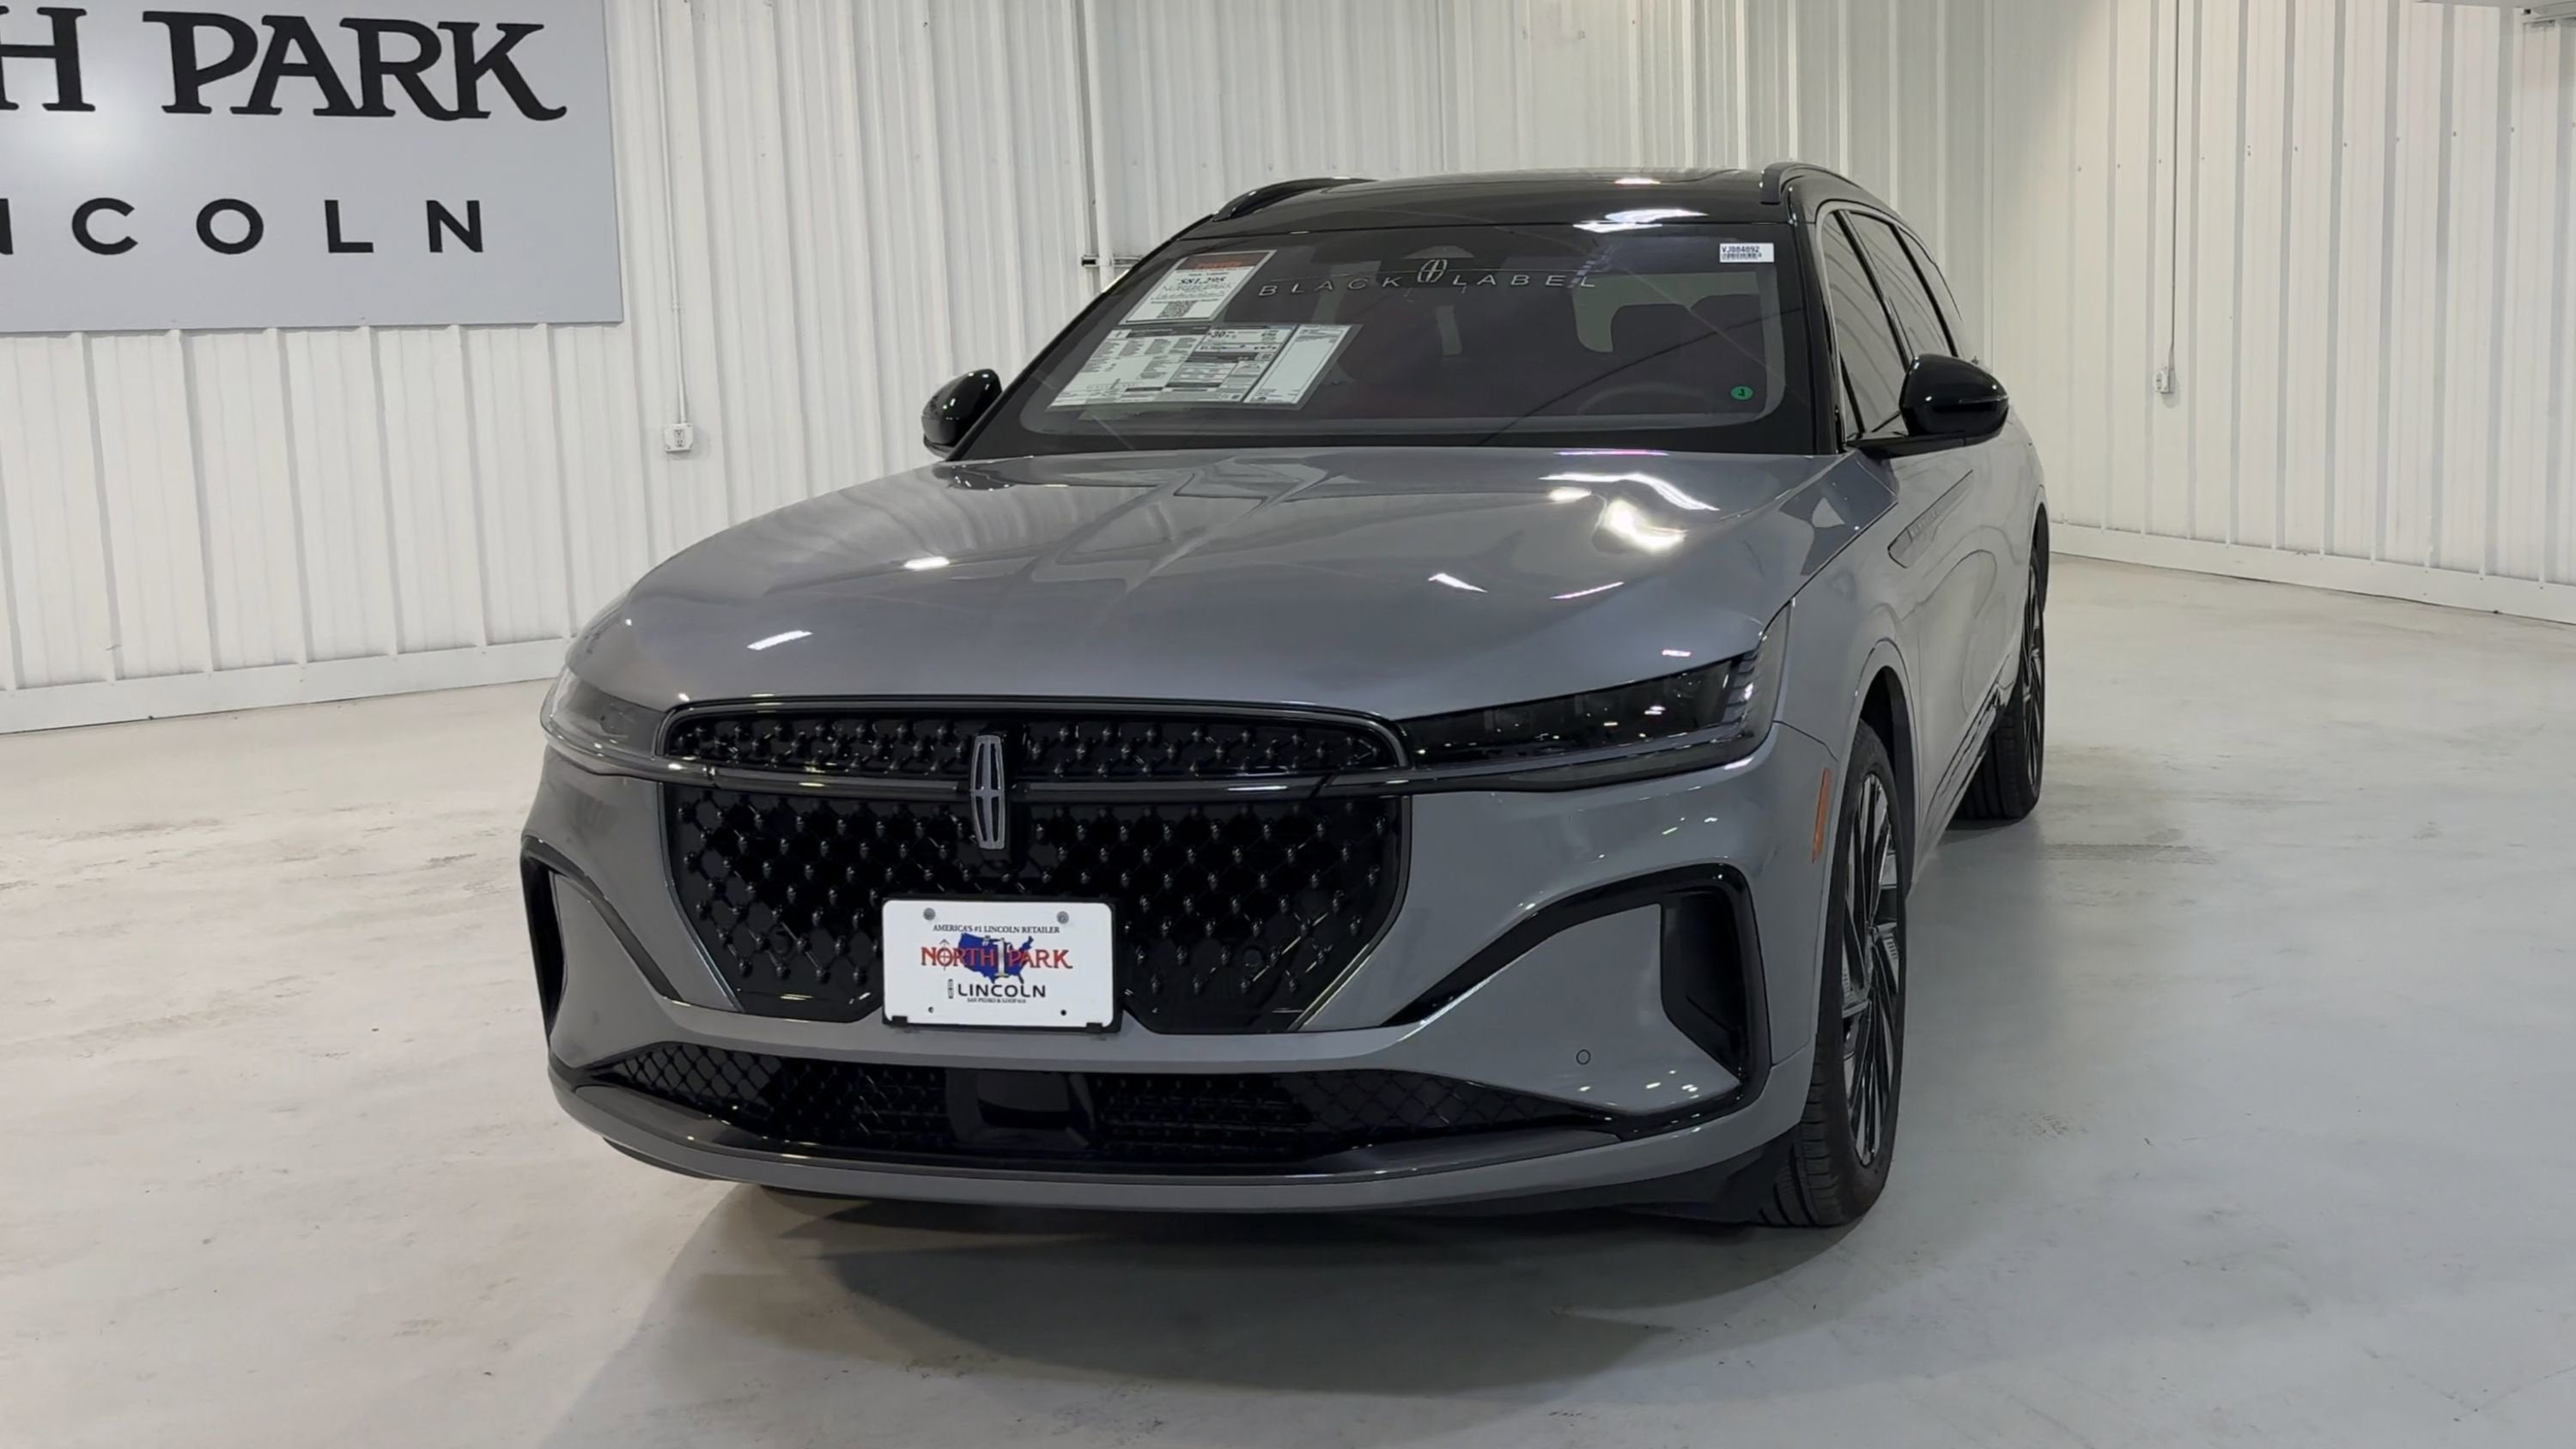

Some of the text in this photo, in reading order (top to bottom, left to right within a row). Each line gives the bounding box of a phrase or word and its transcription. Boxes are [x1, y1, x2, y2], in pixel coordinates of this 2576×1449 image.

[143, 10, 568, 121] PARK
[0, 197, 484, 255] COLN
[1259, 274, 1595, 296] BLACK LABEL
[933, 924, 973, 932] AMERICA'S
[1021, 925, 1060, 934] RETAILER
[920, 946, 1073, 969] NORTH PARK
[957, 983, 1046, 997] LINCOLN
